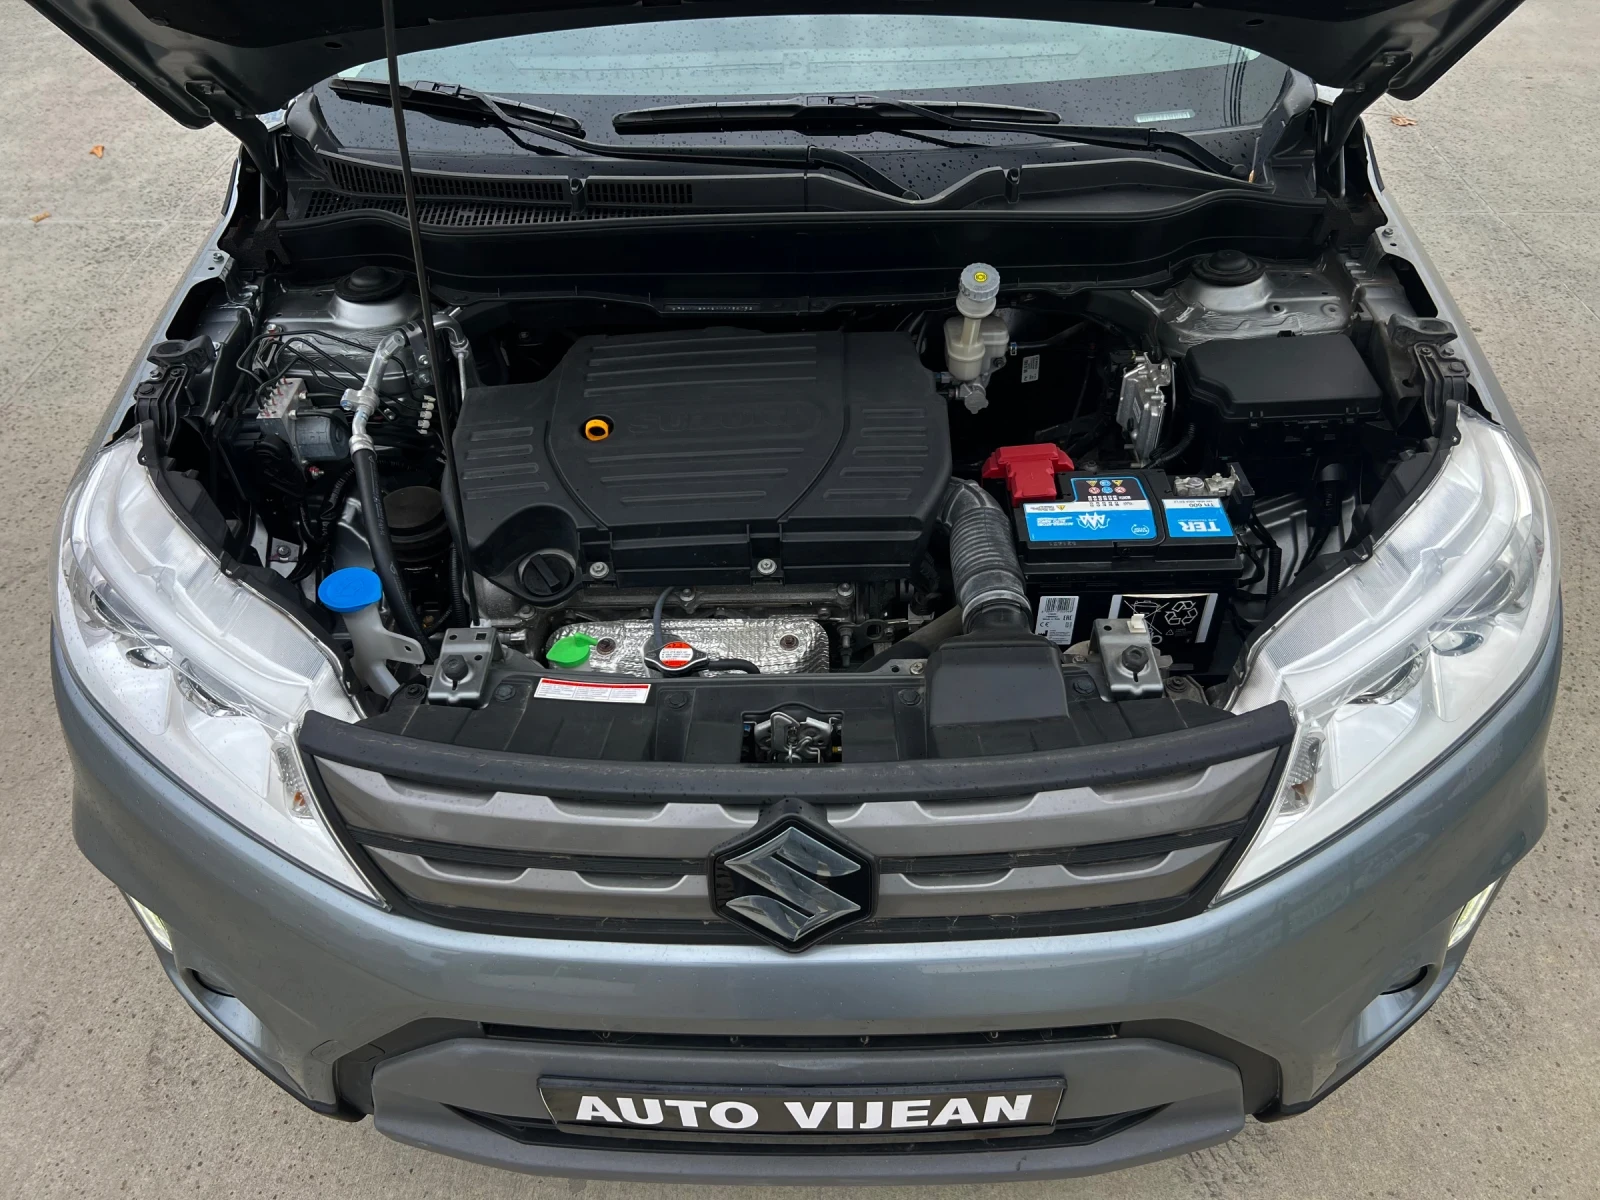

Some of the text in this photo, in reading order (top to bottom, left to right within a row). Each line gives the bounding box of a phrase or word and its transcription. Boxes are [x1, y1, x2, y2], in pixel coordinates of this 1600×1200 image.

[1177, 521, 1221, 532] TER
[575, 1094, 1033, 1130] AUTO VIJEAN
